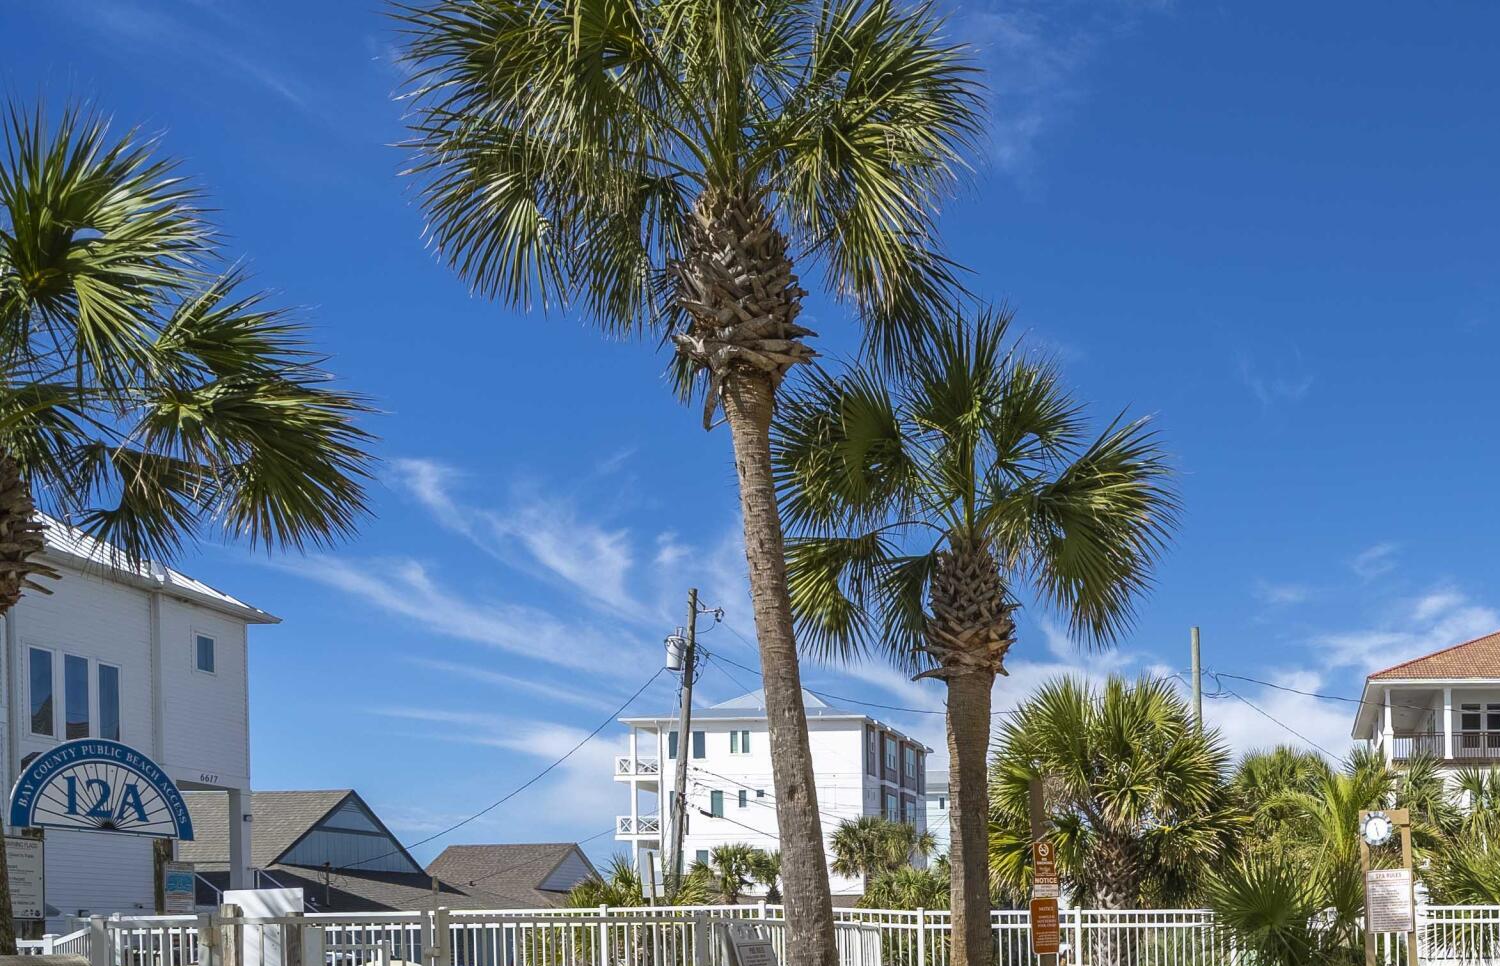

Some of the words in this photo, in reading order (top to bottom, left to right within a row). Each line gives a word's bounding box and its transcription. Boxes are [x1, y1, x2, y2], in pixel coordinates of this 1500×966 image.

[18, 781, 35, 807] BAY
[33, 746, 76, 780] COUNTY
[81, 744, 122, 759] PUBLIC
[126, 752, 159, 780] BEACH
[160, 781, 187, 825] ACCESS
[63, 775, 150, 823] 12A
[200, 773, 219, 784] 6617
